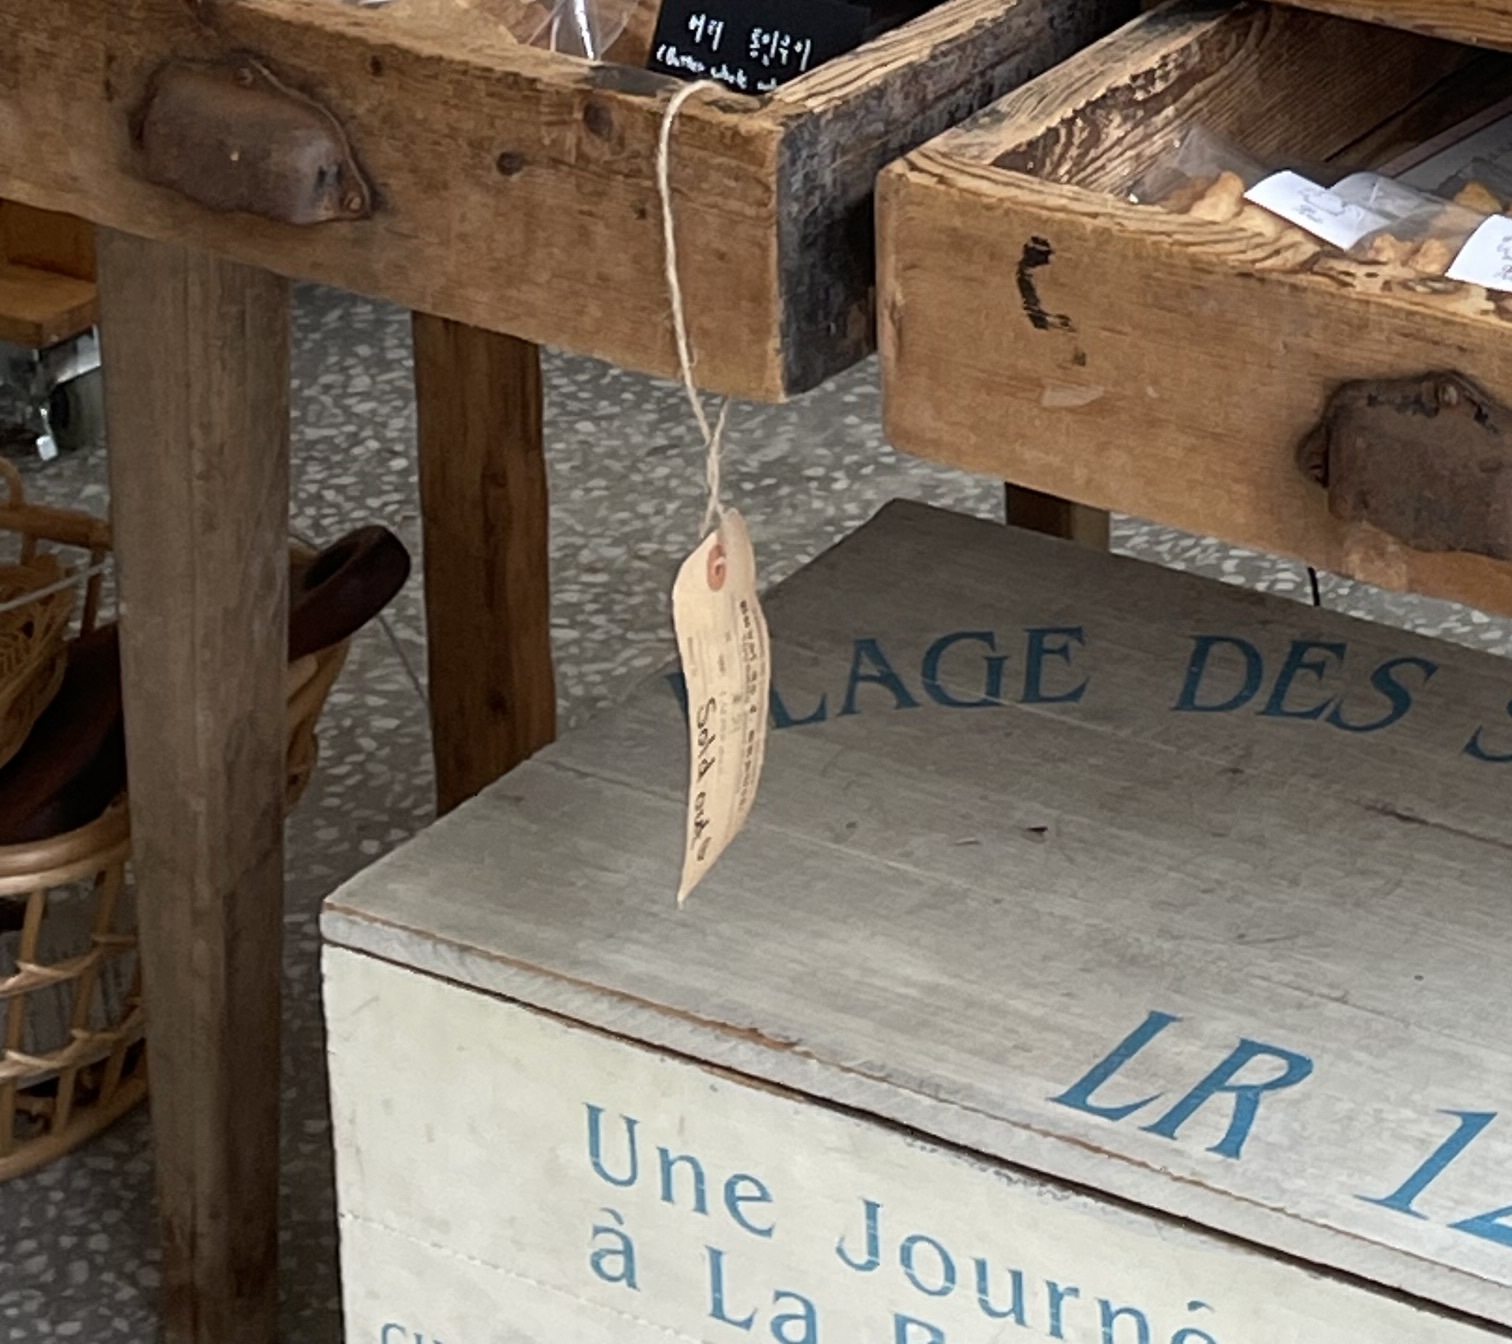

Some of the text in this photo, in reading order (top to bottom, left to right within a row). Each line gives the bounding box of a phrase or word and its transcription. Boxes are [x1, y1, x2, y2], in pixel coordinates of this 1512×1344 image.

[688, 13, 725, 52] 버터
[1173, 628, 1440, 733] DES
[1049, 1009, 1315, 1161] LR
[584, 1102, 776, 1238] Une
[588, 1209, 820, 1343] à La
